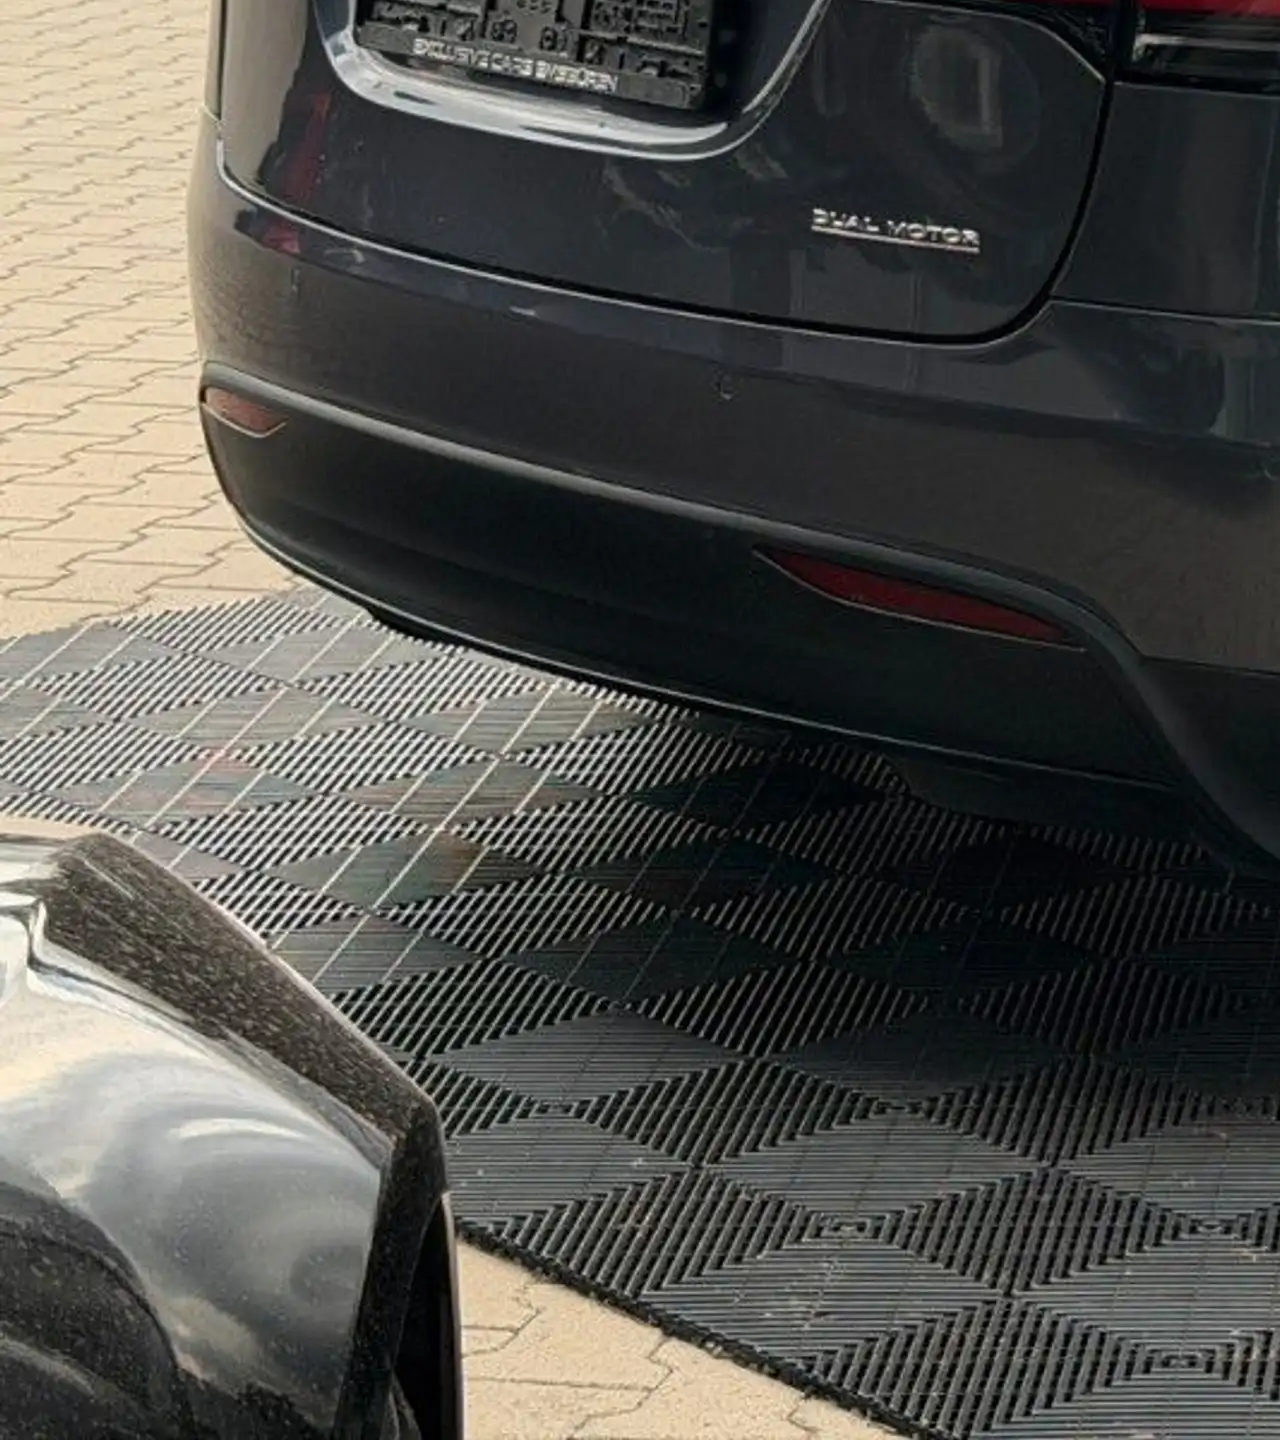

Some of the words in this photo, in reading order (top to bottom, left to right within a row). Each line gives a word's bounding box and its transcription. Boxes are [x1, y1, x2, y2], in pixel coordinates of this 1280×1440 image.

[412, 37, 490, 69] EXCLUSIVE
[491, 50, 534, 77] CARS
[812, 207, 880, 232] DUAL
[886, 219, 981, 246] MOTOR
